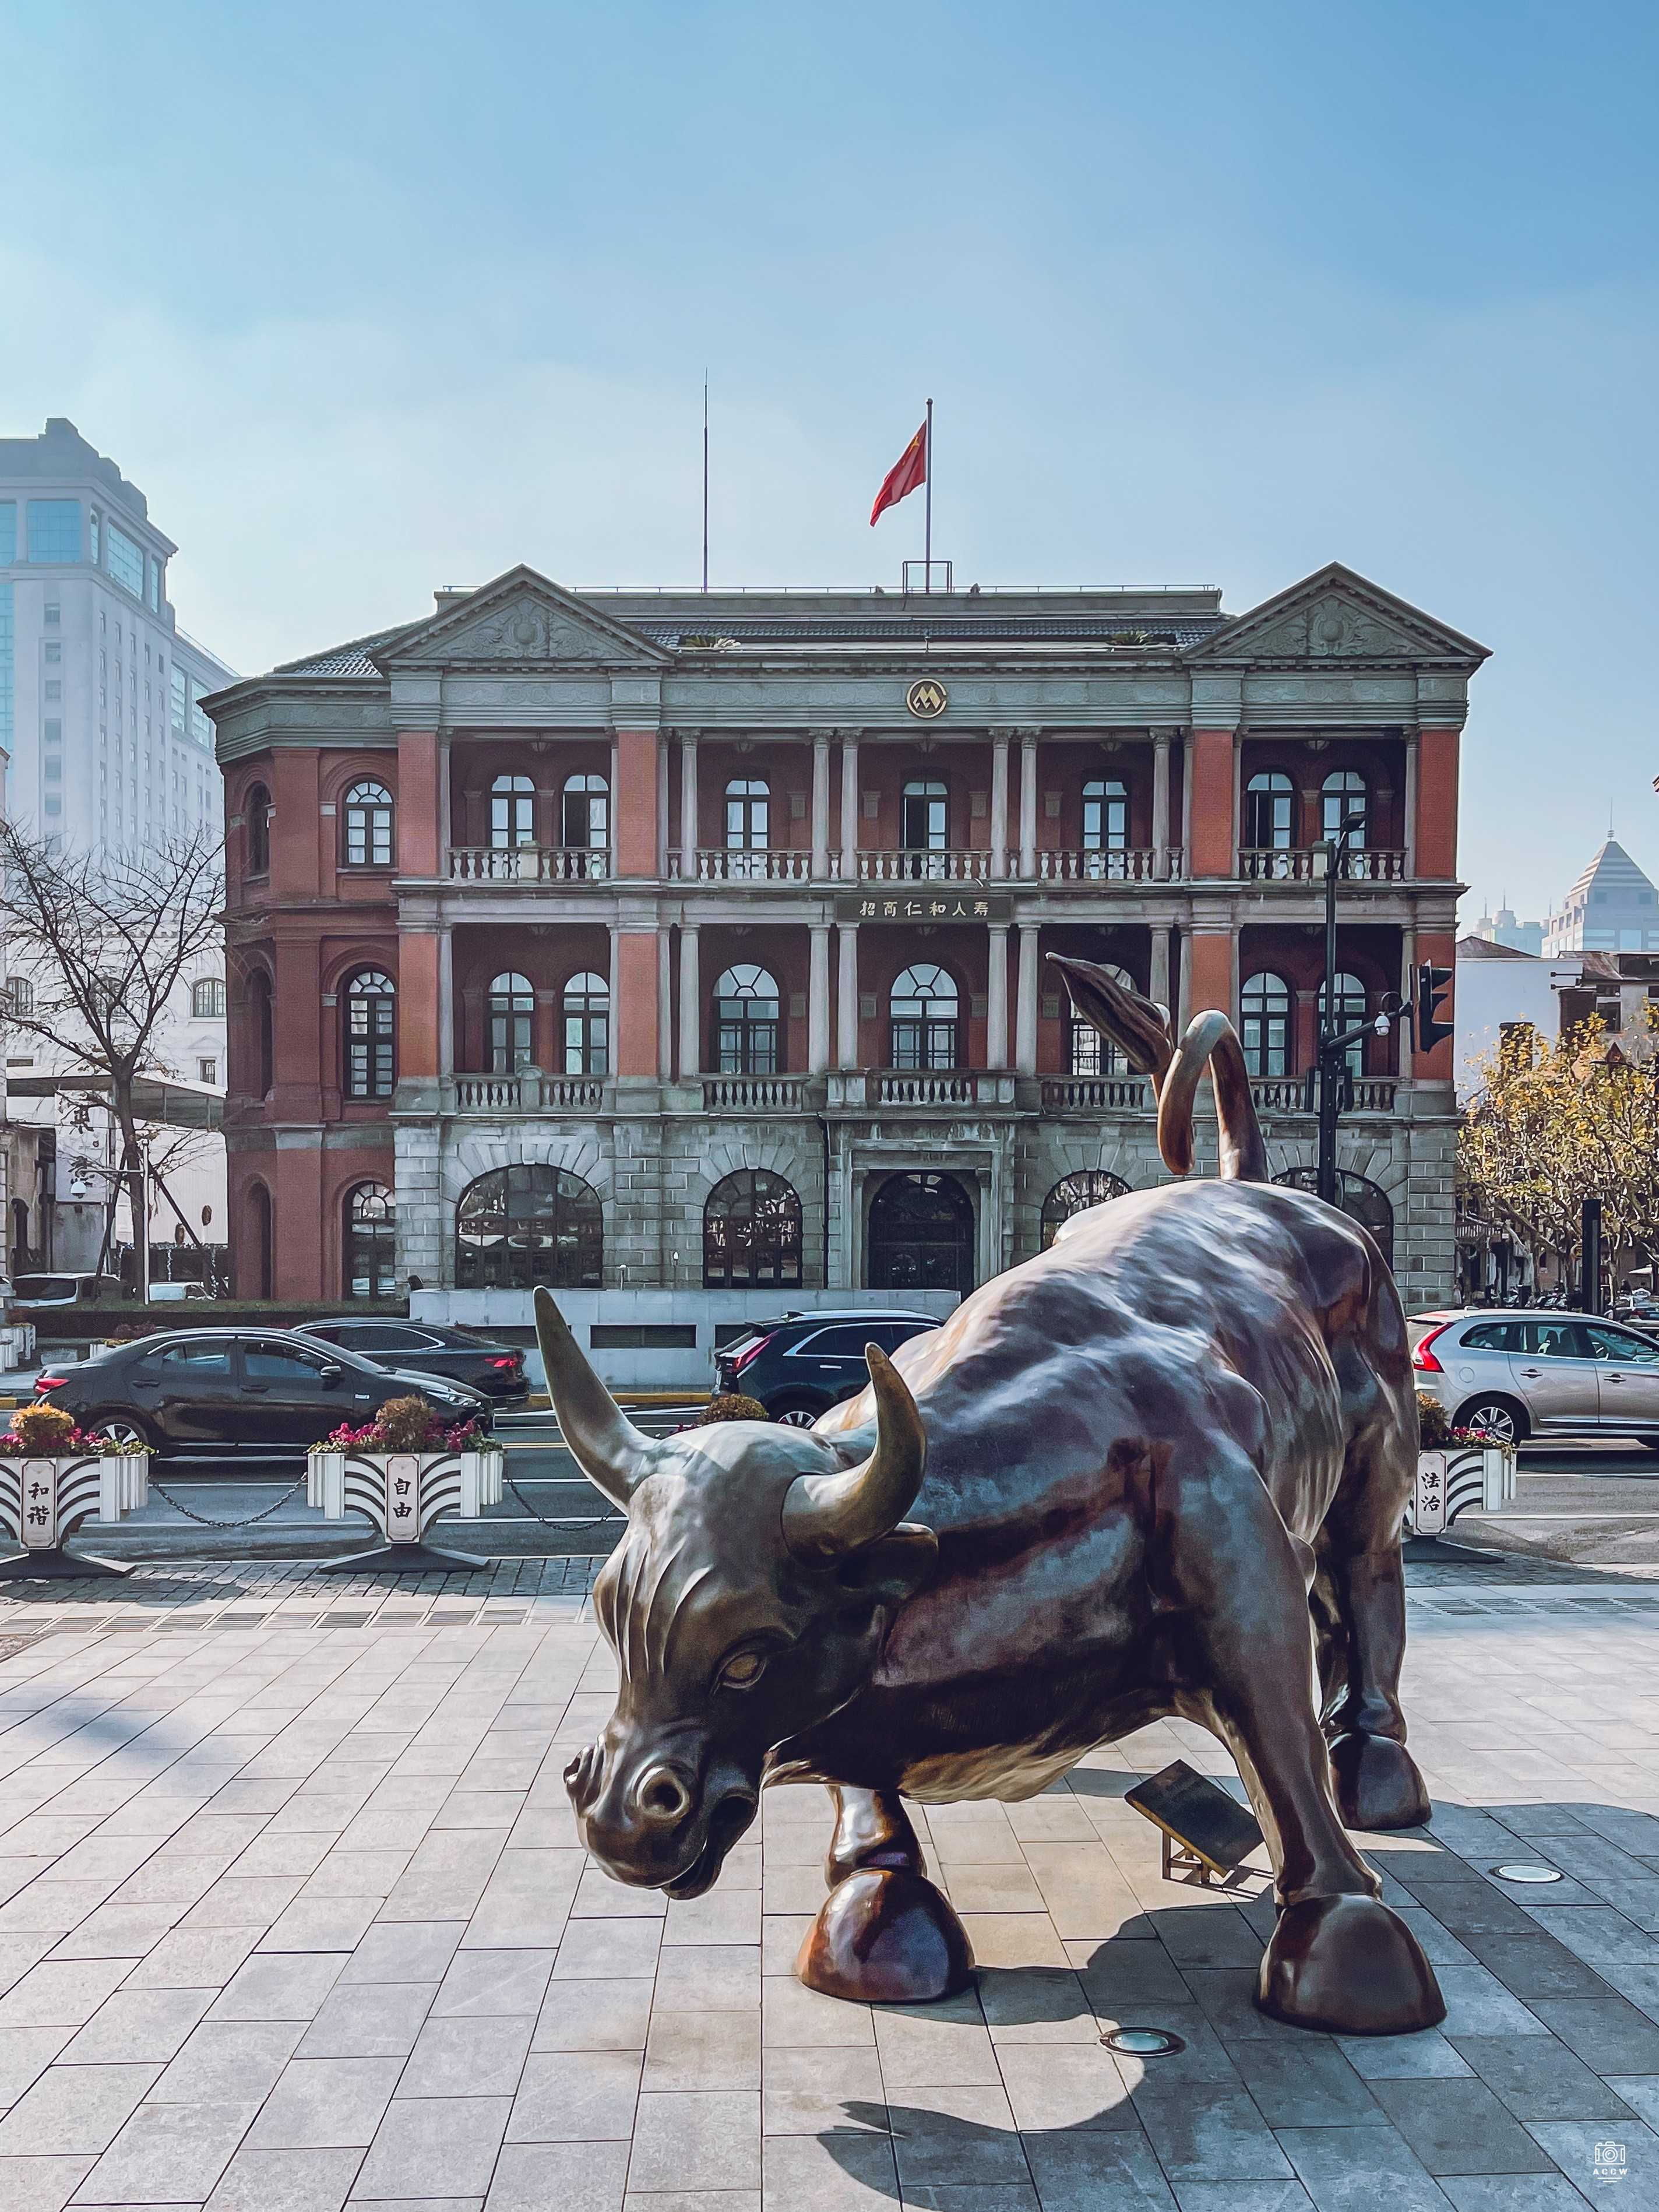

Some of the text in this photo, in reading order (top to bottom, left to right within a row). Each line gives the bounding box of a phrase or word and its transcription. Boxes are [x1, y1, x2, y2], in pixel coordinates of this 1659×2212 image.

[860, 900, 989, 917] 招商仁和人寿
[26, 1482, 50, 1526] 和谐
[392, 1477, 413, 1519] 自由
[1421, 1472, 1441, 1512] 法治
